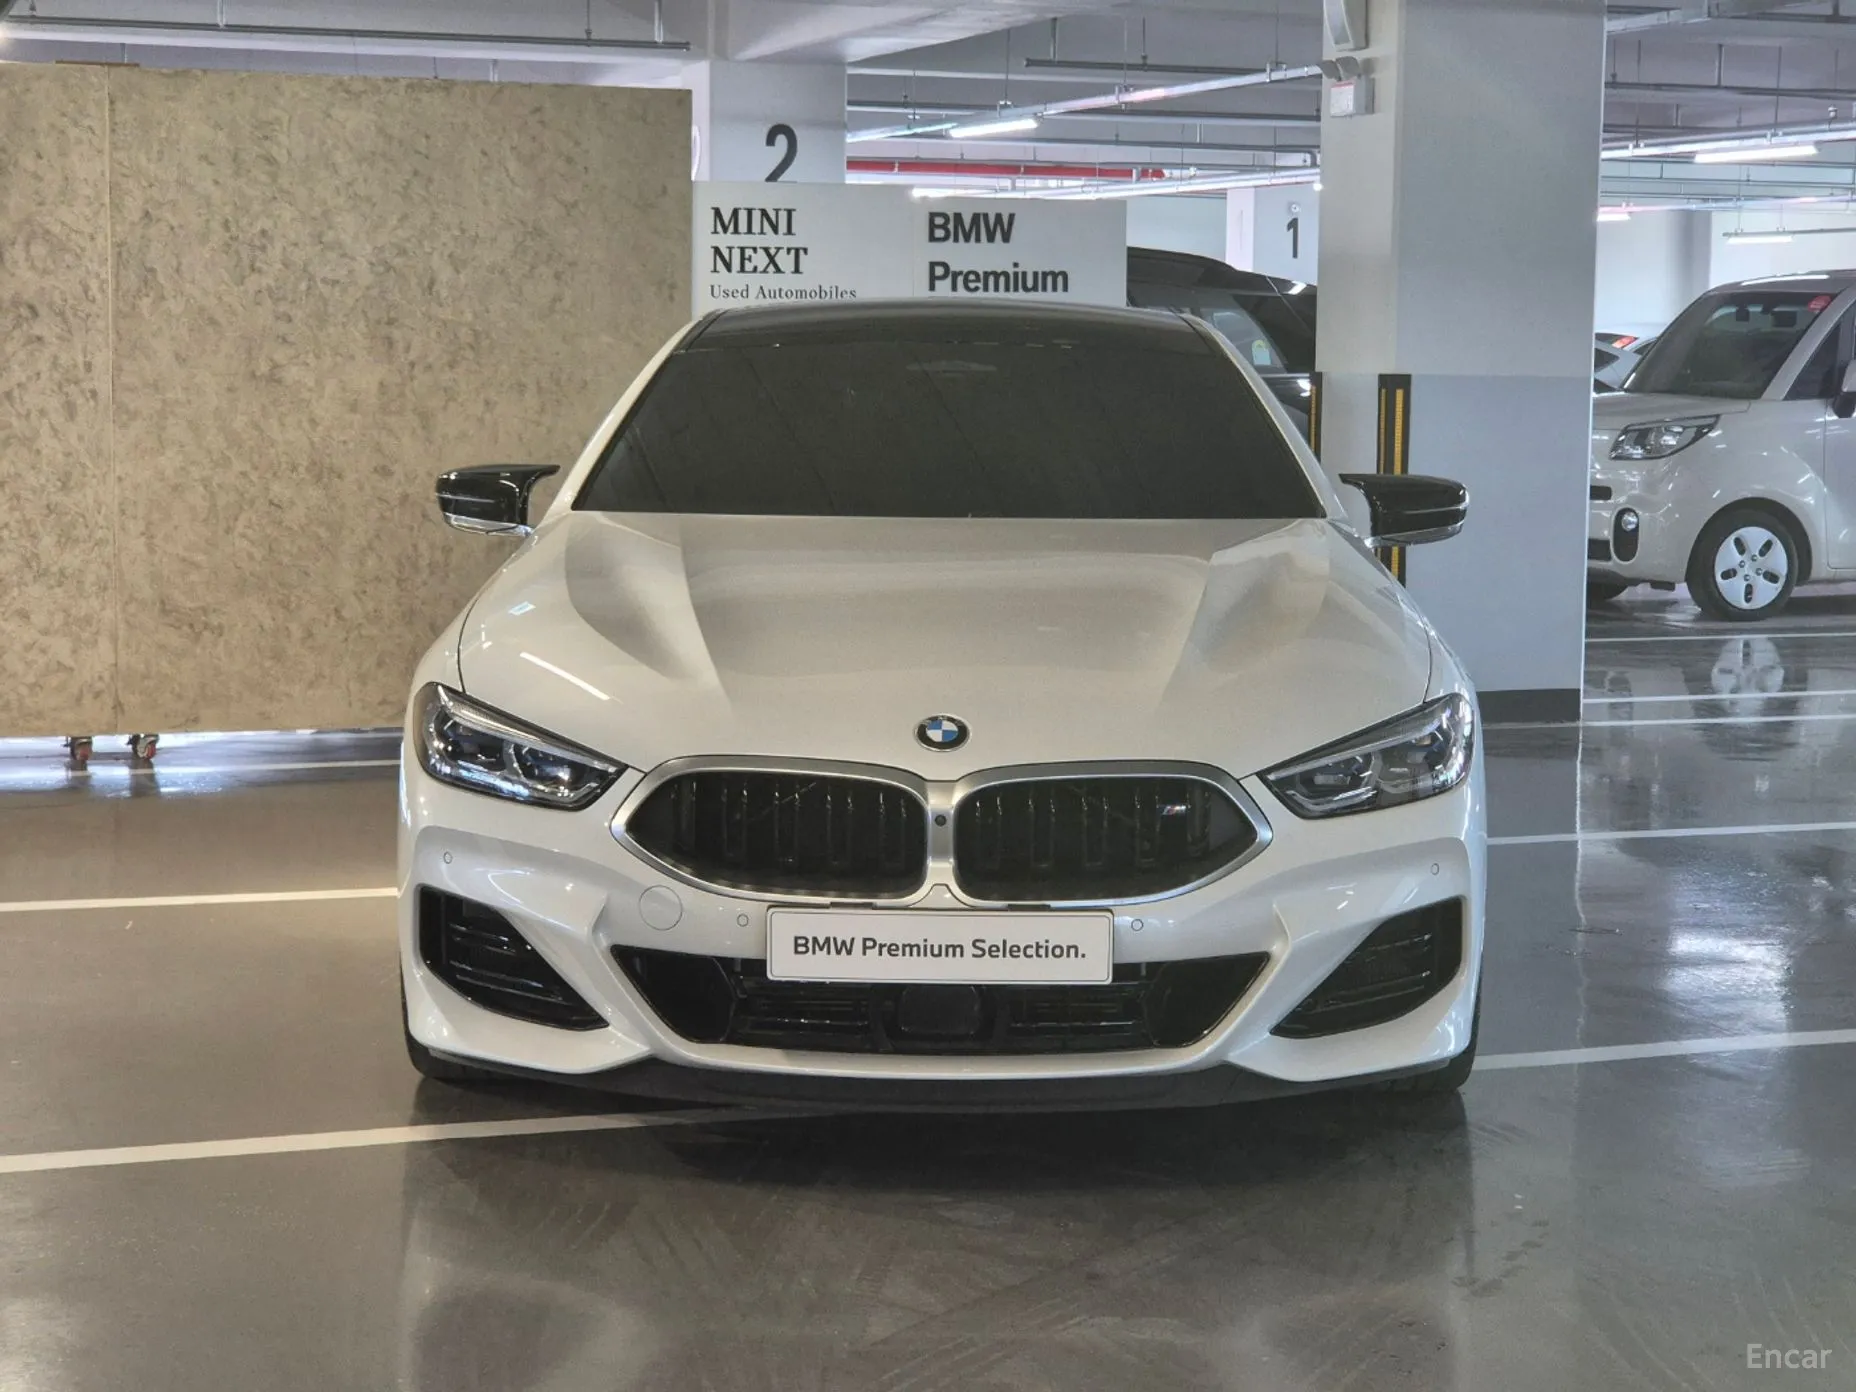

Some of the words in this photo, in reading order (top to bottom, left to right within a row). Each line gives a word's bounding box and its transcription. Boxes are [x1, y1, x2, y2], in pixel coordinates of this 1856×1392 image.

[765, 123, 798, 183] 2
[711, 206, 797, 236] MINI
[928, 212, 1016, 244] BMW
[1286, 217, 1299, 259] 1
[710, 245, 809, 275] NEXT
[710, 283, 749, 299] Used
[755, 284, 857, 300] Automobiles
[928, 260, 1069, 293] Premium
[793, 935, 856, 956] BMW
[861, 937, 965, 958] Premium
[971, 938, 1087, 960] Selection.
